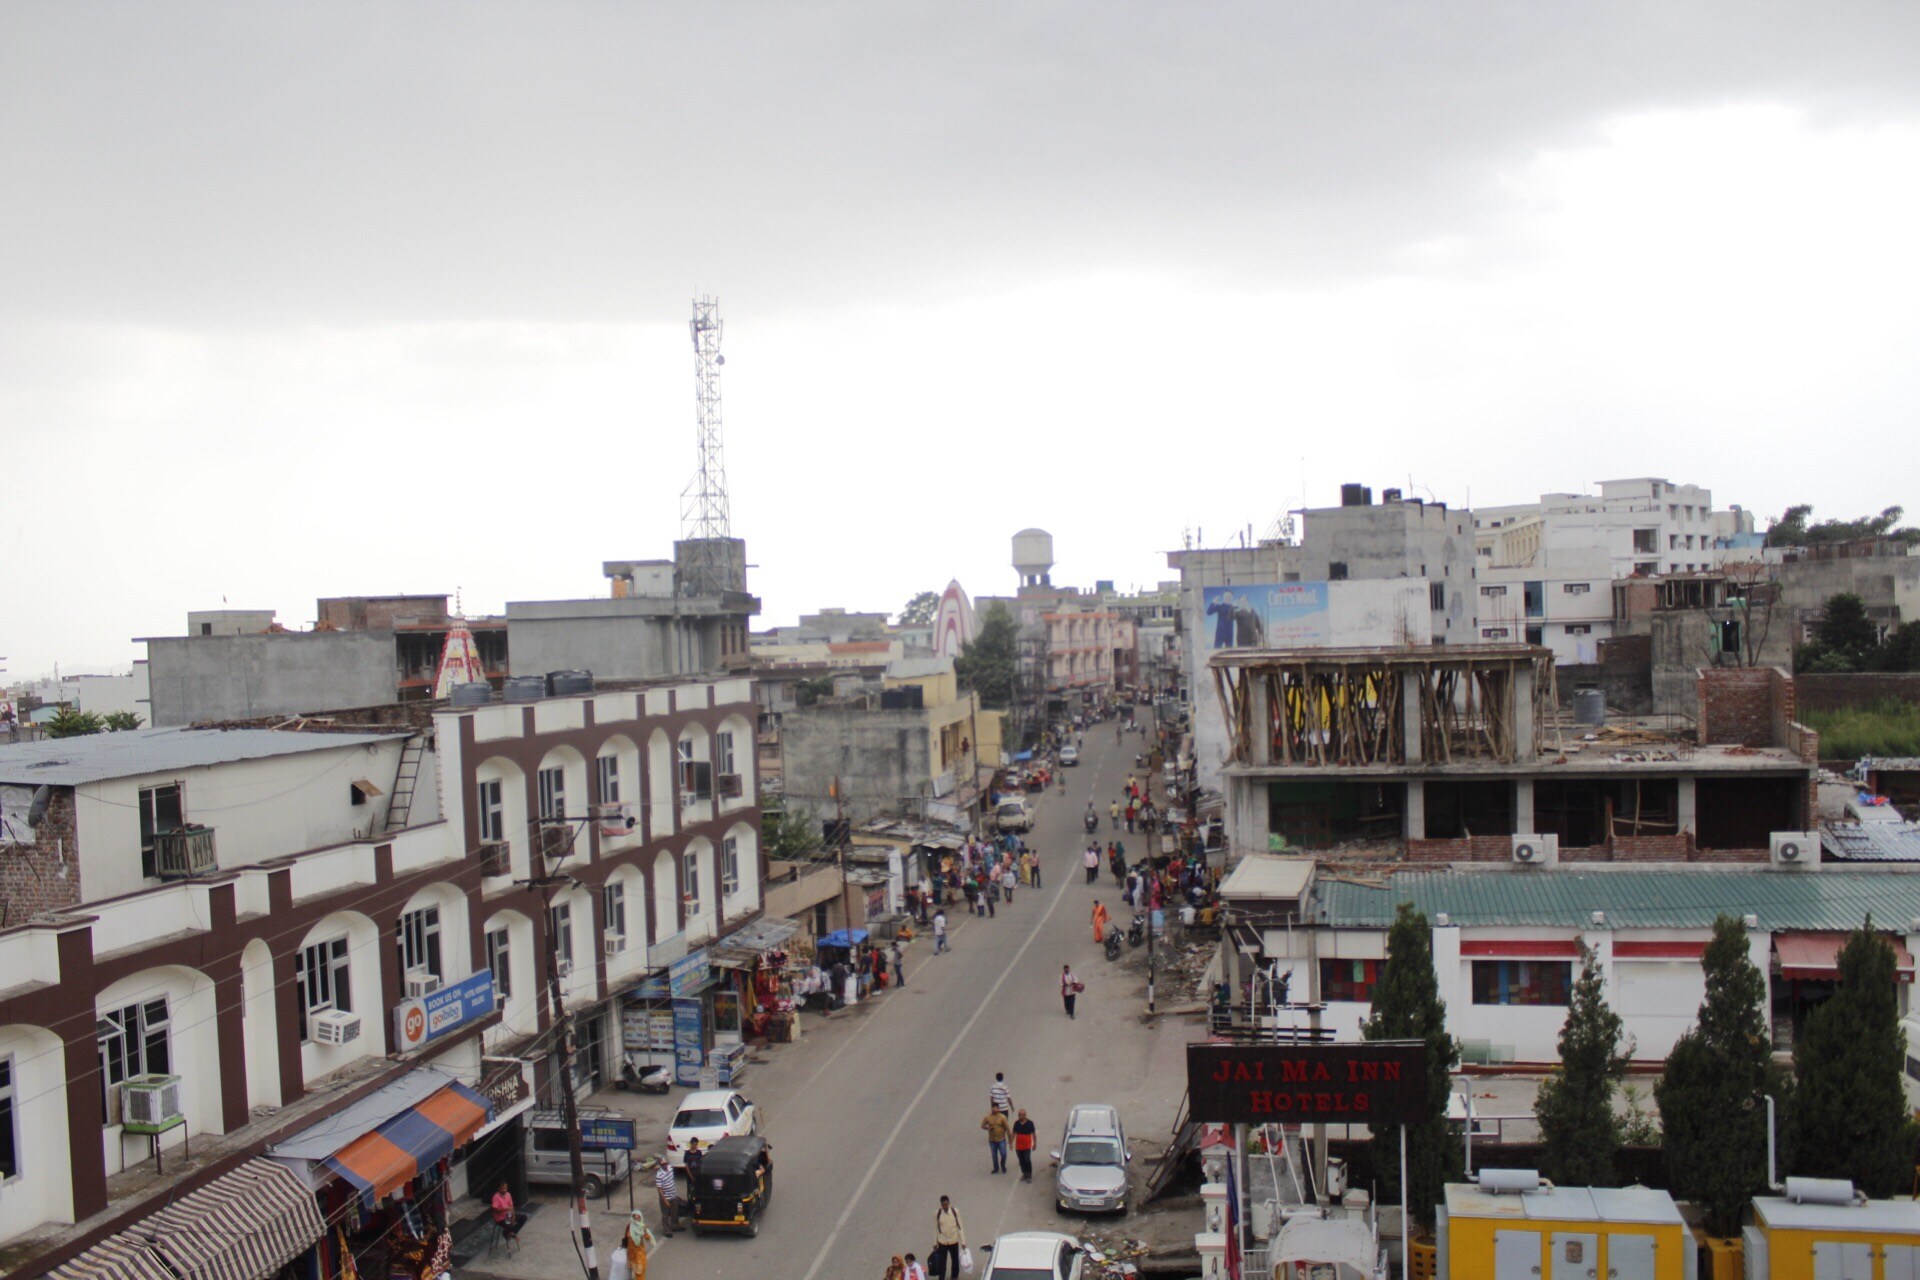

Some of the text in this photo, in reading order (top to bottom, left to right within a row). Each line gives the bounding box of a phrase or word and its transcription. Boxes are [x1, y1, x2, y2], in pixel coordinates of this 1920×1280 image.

[428, 988, 462, 1010] BOOK US ON
[407, 1014, 422, 1036] go
[432, 1006, 459, 1028] goibibo
[1212, 1060, 1402, 1083] JAI MA INN
[1251, 1091, 1370, 1113] HOTELS
[591, 1128, 617, 1136] HOTEL
